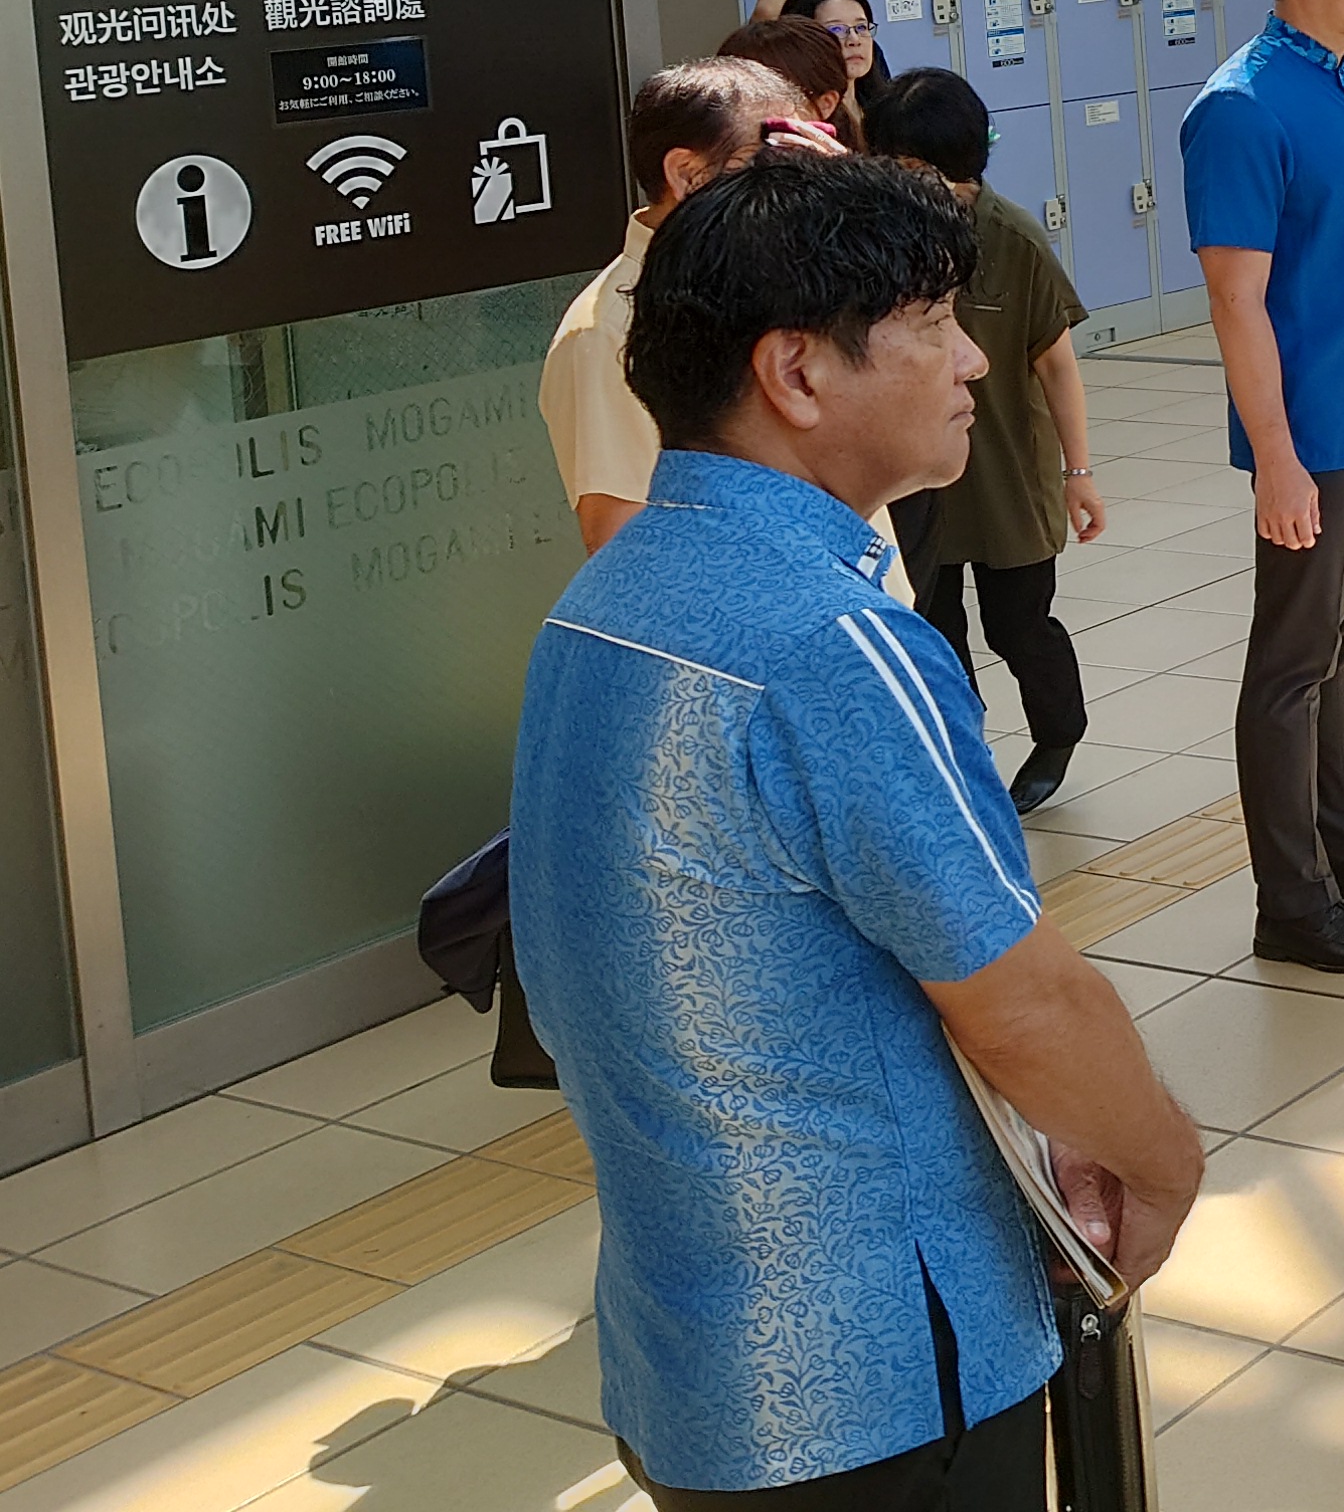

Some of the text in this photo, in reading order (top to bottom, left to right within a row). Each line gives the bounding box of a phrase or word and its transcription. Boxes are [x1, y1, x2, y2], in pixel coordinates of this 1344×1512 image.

[59, 2, 237, 47] 观光问讯处
[64, 56, 228, 102] 관광안내소
[315, 213, 411, 246] FREE WiFi
